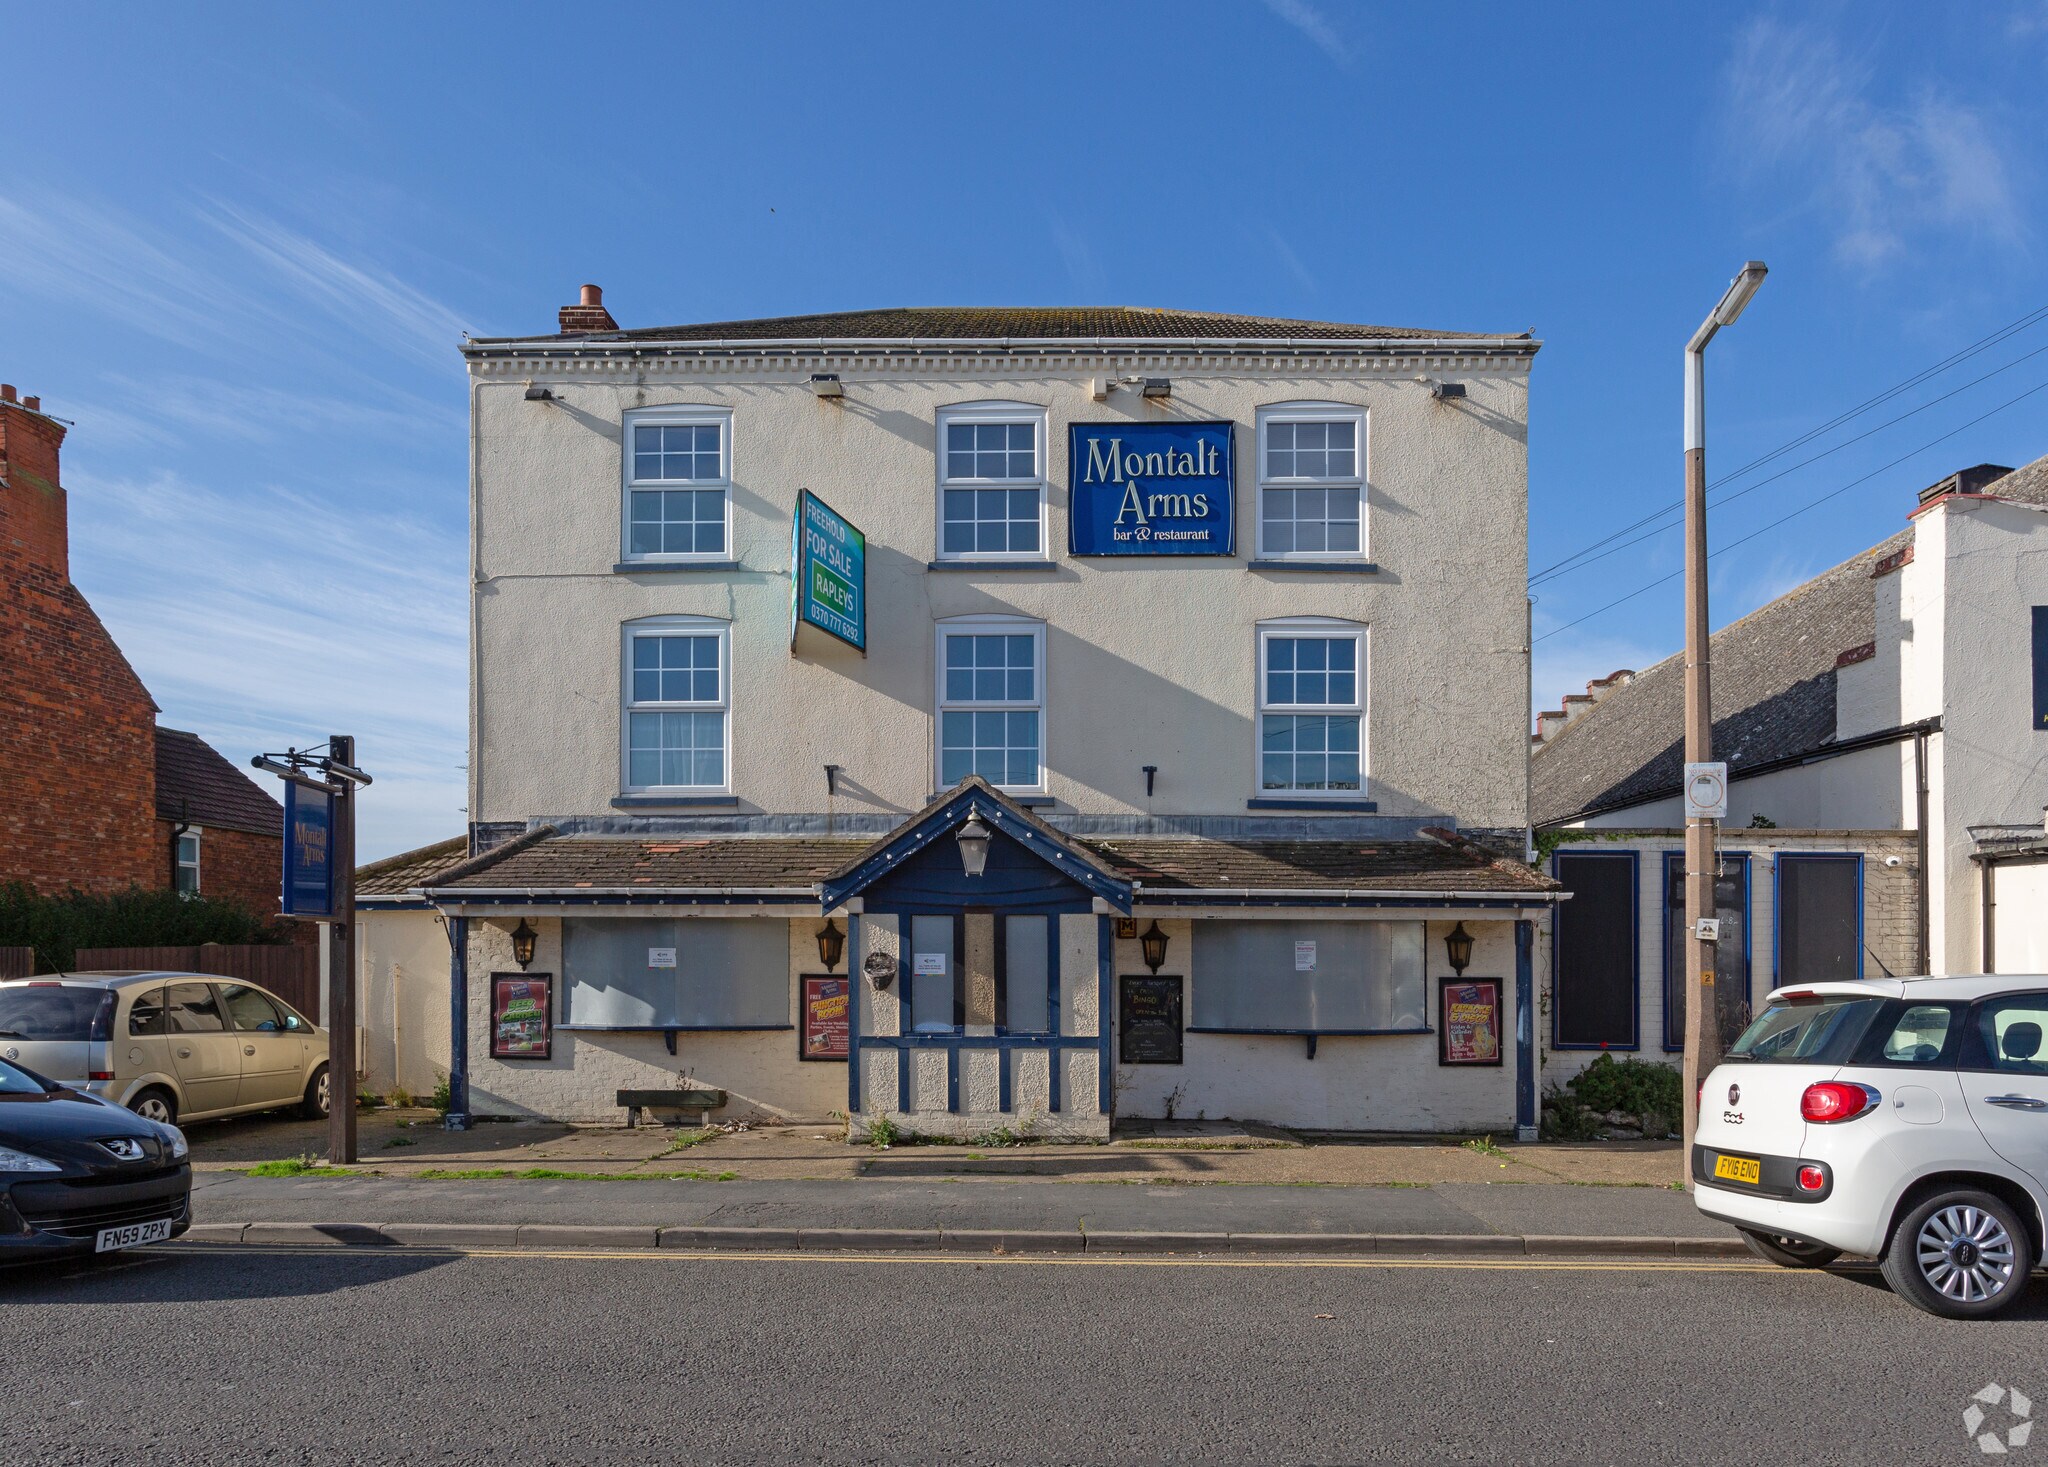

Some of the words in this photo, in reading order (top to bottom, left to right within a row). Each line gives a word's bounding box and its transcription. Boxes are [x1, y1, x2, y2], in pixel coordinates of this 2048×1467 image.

[1083, 437, 1221, 483] Montalt
[1113, 479, 1209, 525] Arms
[806, 501, 846, 544] FREEHOLD
[1113, 527, 1133, 541] bar
[1134, 526, 1151, 541] &
[1154, 528, 1210, 541] restaurant
[806, 527, 827, 561] FOR
[828, 545, 852, 578] SALE
[816, 572, 854, 612] RAPLEYS
[811, 604, 829, 625] 0370
[829, 613, 842, 633] 777
[842, 621, 859, 642] 6292
[302, 843, 325, 867] Arms
[1705, 974, 1711, 982] 2
[1133, 995, 1157, 1004] BINGO
[1451, 1003, 1493, 1015] KARAOKE
[817, 1006, 845, 1020] ROOM
[1460, 1013, 1489, 1024] DISCO
[1719, 1158, 1739, 1175] FY16
[102, 1226, 140, 1248] FN59
[141, 1221, 167, 1241] ZPX
